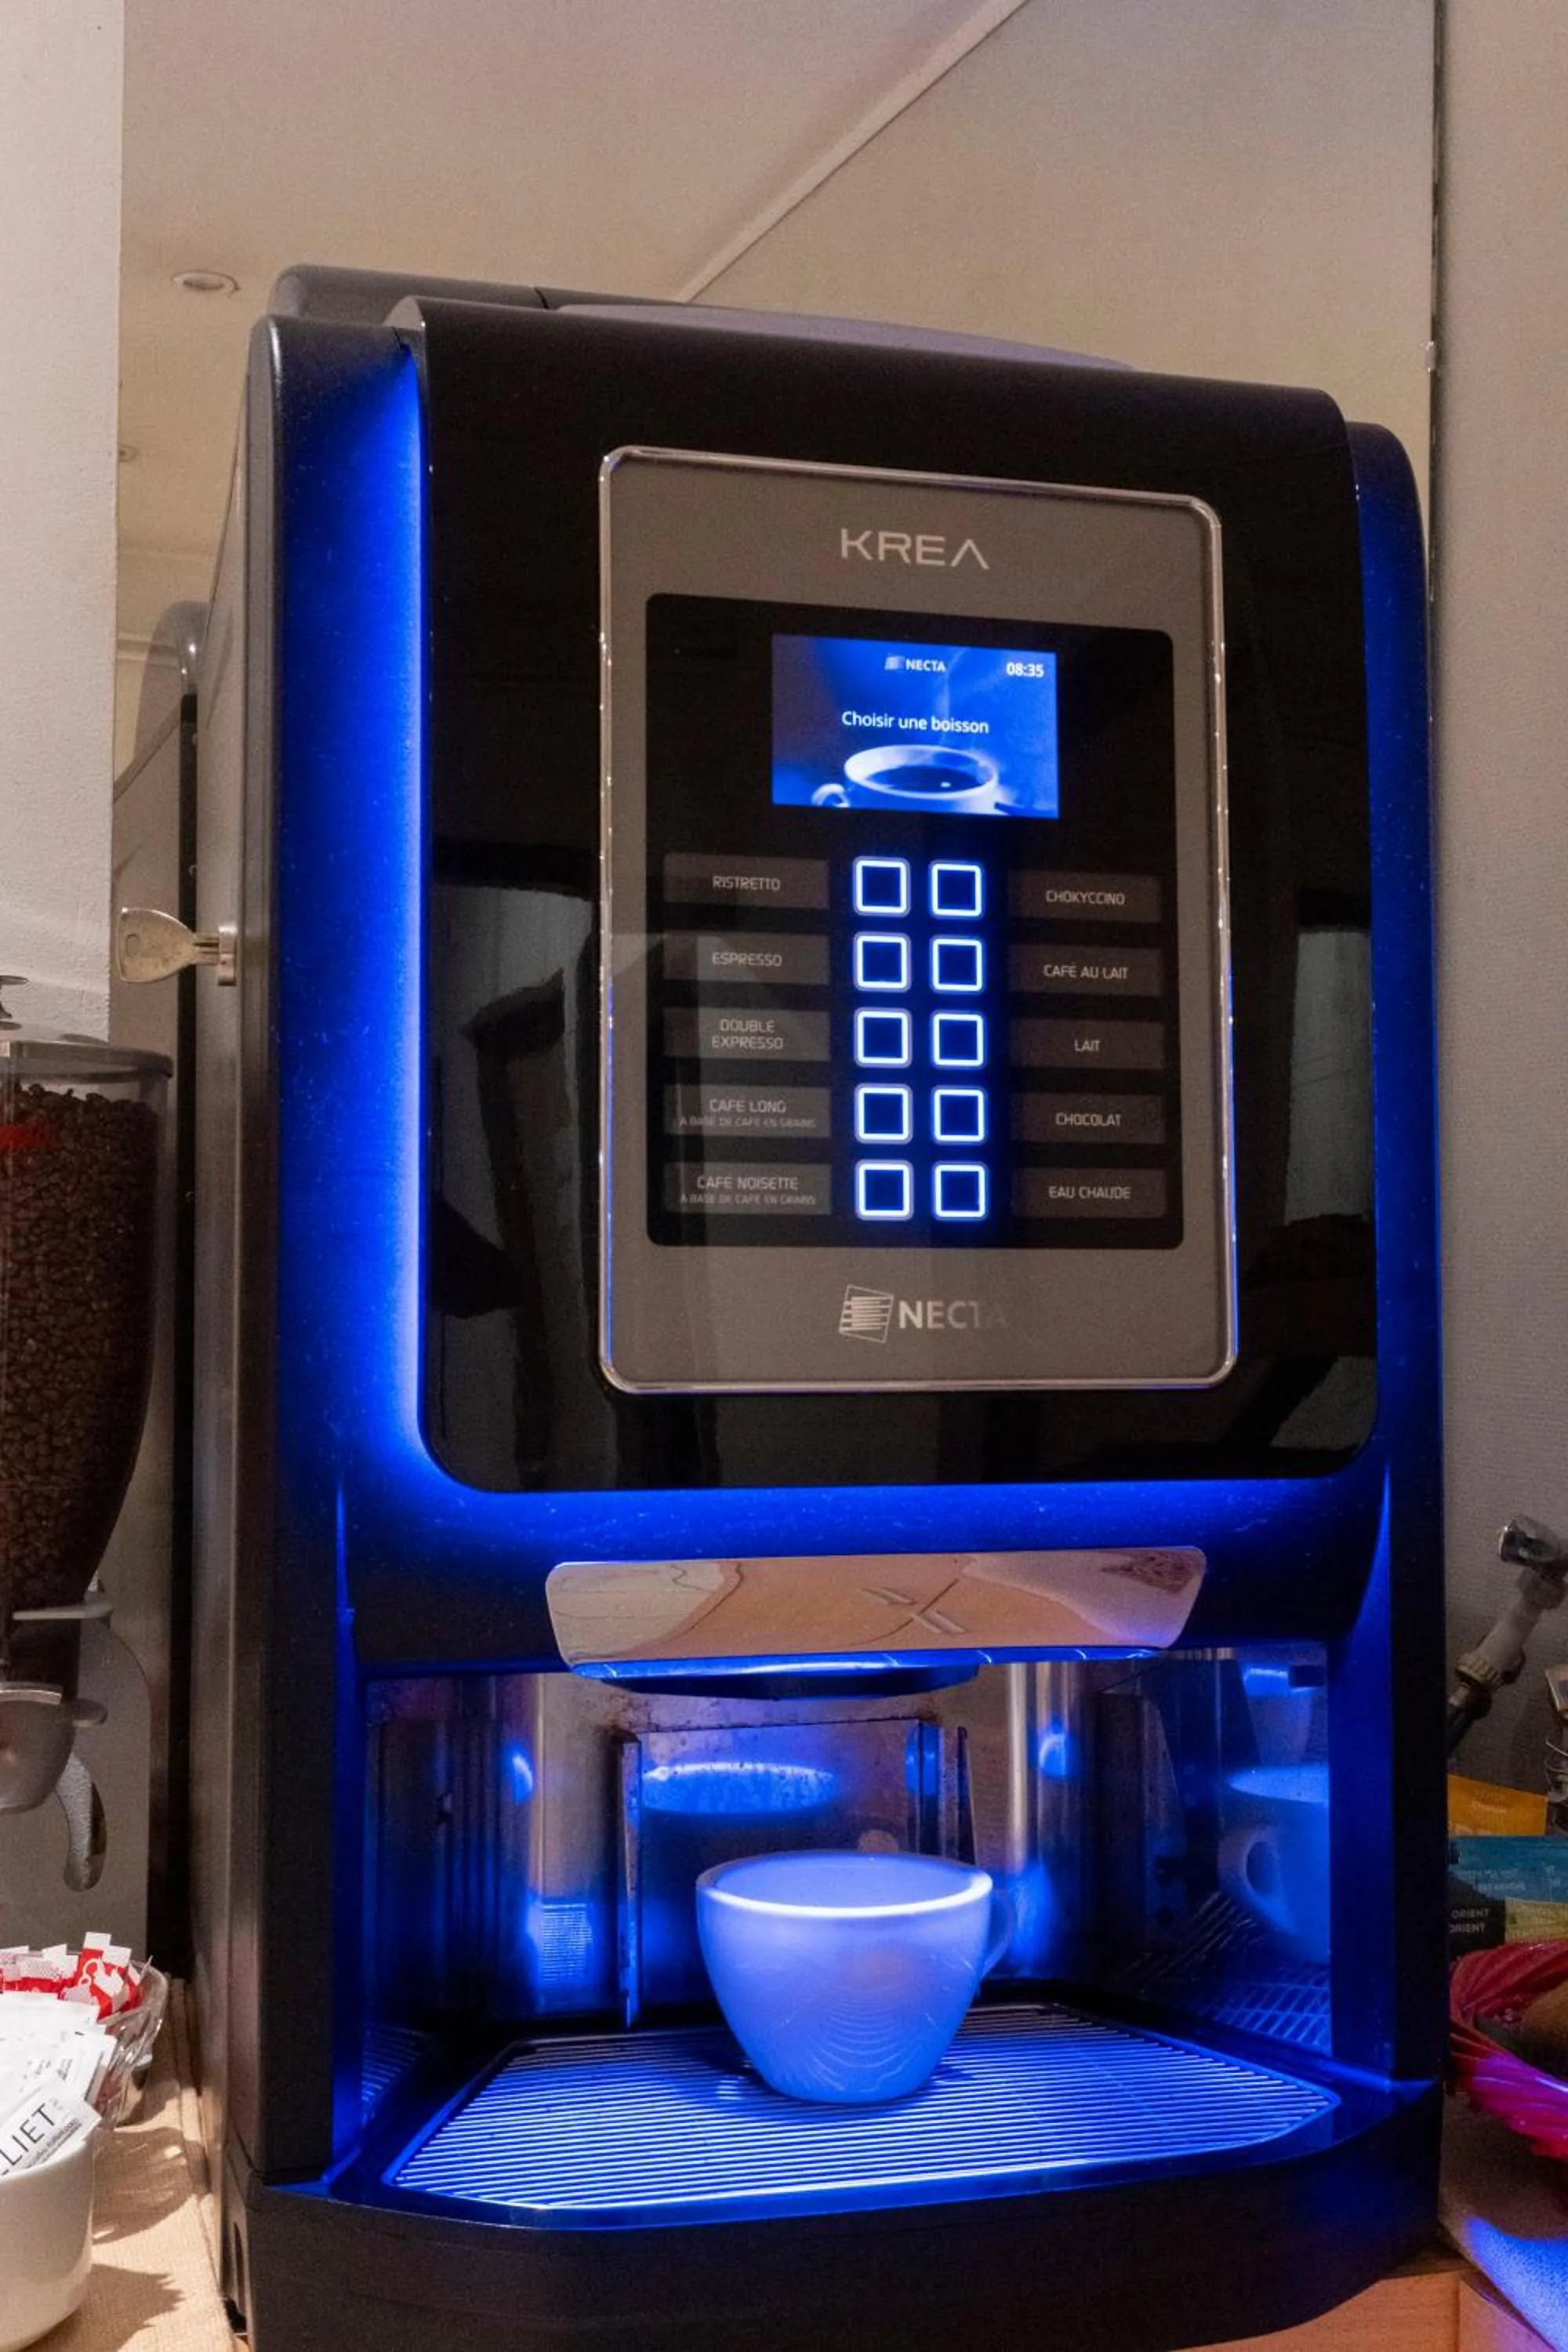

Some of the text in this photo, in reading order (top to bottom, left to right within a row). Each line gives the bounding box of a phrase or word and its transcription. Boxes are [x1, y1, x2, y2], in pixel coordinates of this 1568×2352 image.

[840, 528, 989, 570] KREA
[906, 658, 946, 673] NECTA
[1006, 662, 1044, 678] 08:35
[841, 710, 989, 734] Choisir une boisson
[712, 875, 782, 891] RISTRETTO
[1045, 890, 1126, 906] CHOKYCCINO
[712, 952, 782, 967] ESPRESSO
[1080, 965, 1099, 979] AU
[1102, 967, 1129, 979] LAIT
[720, 1019, 775, 1032] DOUBLE
[711, 1036, 783, 1049] EXPRESSO
[1074, 1040, 1101, 1051] LAIT
[750, 1101, 786, 1113] LONG
[1055, 1112, 1122, 1127] CHOCOLAT
[737, 1177, 800, 1191] NOISETTE
[1048, 1186, 1131, 1199] EAU CHAUDE
